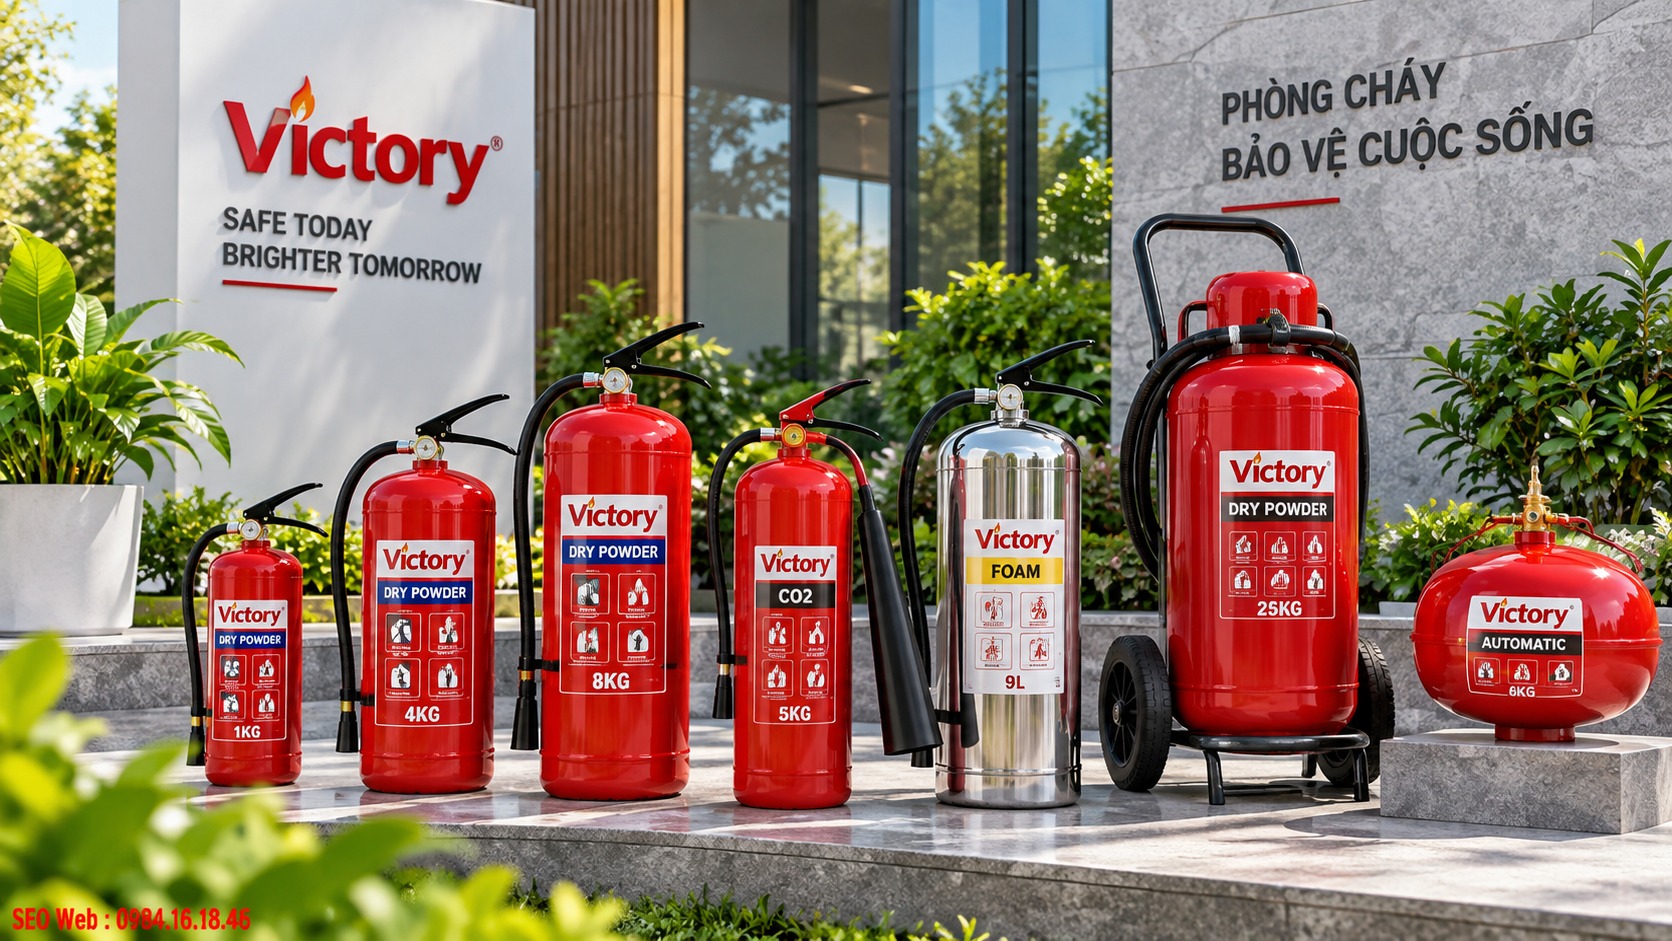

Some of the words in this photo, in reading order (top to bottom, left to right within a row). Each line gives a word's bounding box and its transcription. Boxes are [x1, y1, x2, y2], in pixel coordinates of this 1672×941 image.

[1222, 77, 1333, 125] PHÒNG
[1344, 57, 1446, 109] CHÁY
[1222, 132, 1290, 181] BẢO
[1302, 127, 1347, 178] VỆ
[1358, 117, 1463, 170] CUỘC
[1475, 101, 1594, 155] SỐNG
[222, 206, 287, 235] SAFE
[294, 212, 373, 242] TODAY
[222, 241, 342, 274] BRIGHTER
[349, 252, 482, 284] TOMORROW
[1229, 452, 1326, 489] Victory
[568, 497, 658, 532] Victory
[1228, 502, 1260, 516] DRY
[1264, 502, 1327, 516] POWDER
[975, 523, 1055, 554] Victory
[383, 543, 465, 575] Victory
[569, 545, 595, 558] DRY
[599, 545, 658, 558] POWDER
[760, 549, 831, 577] Victory
[991, 564, 1041, 578] FOAM
[384, 587, 407, 598] DRY
[411, 587, 466, 598] POWDER
[778, 588, 813, 604] CO2
[218, 602, 281, 626] Victory
[1257, 601, 1302, 616] 25KG
[1480, 598, 1569, 629] Victory
[219, 635, 237, 645] DRY
[240, 635, 281, 645] POWDER
[1481, 636, 1566, 651] AUTOMATIC
[592, 672, 630, 690] 8KG
[1005, 675, 1025, 689] 9L
[404, 706, 440, 722] 4KG
[778, 706, 811, 721] 5KG
[234, 725, 260, 738] 1KG
